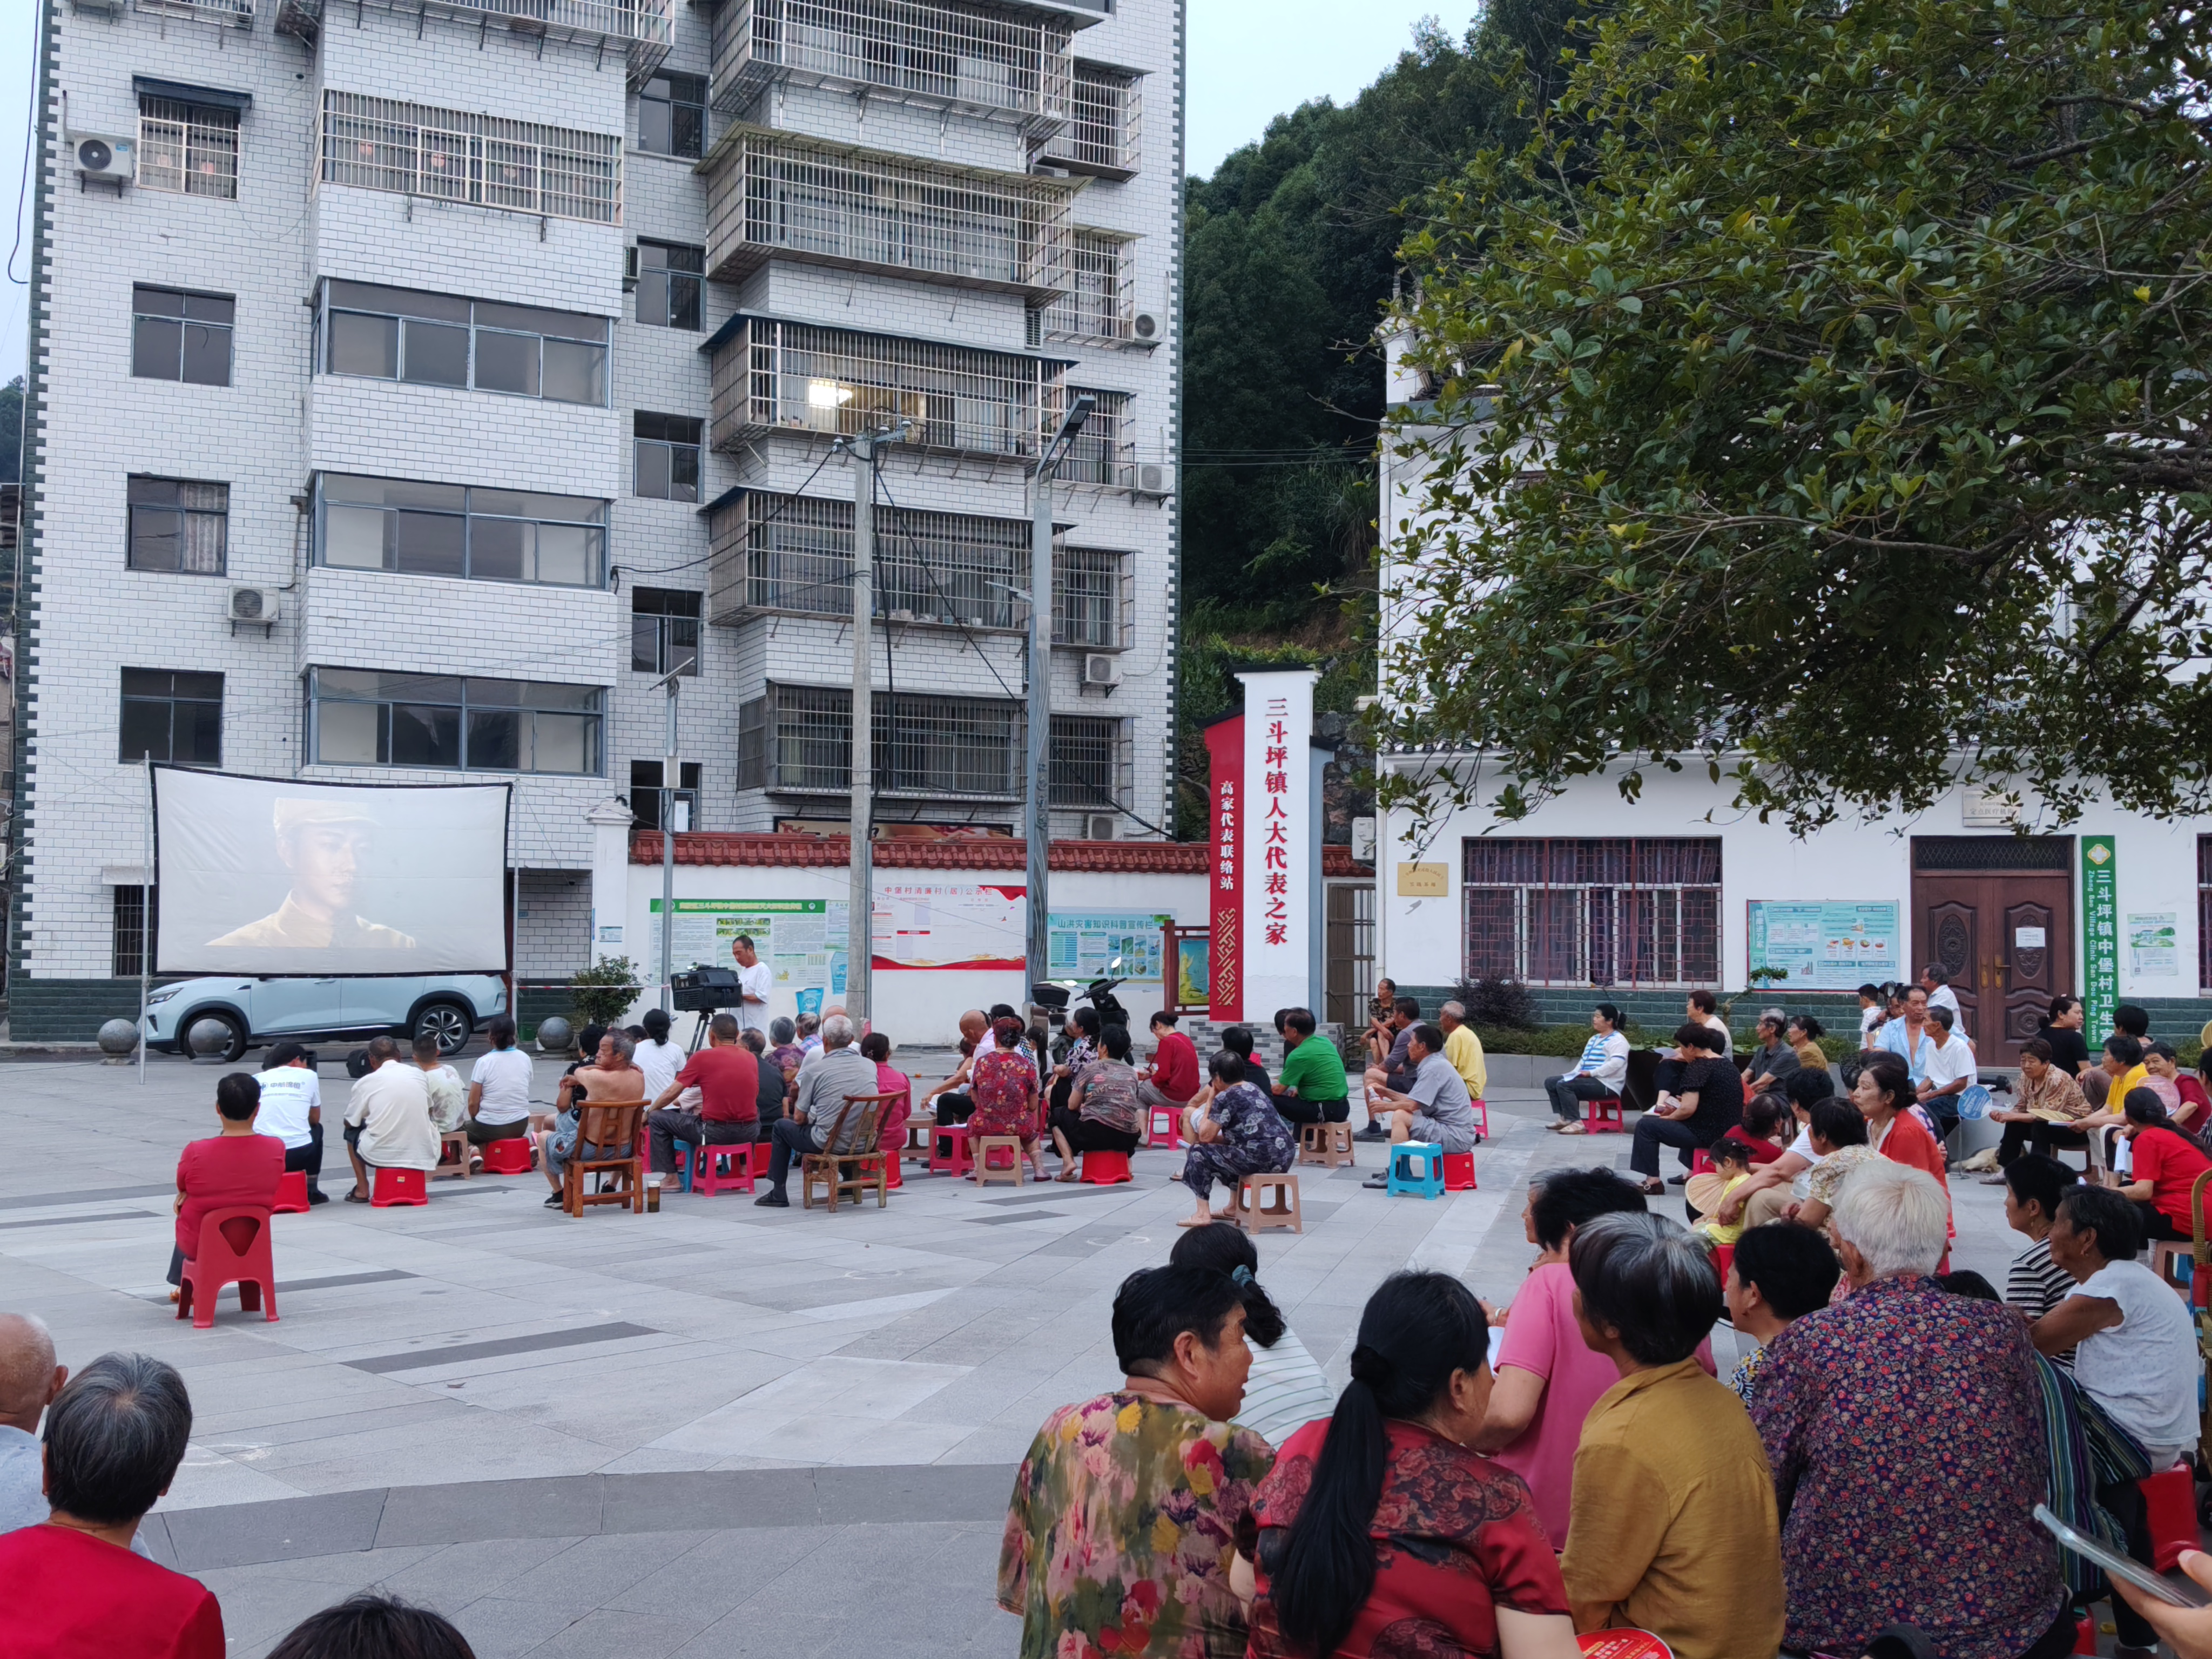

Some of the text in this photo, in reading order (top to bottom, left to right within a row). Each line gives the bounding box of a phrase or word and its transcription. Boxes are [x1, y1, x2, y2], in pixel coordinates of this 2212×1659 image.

[1220, 780, 1234, 890] 高家代表联络站
[1265, 698, 1288, 946] 三斗坪镇人大代表之家
[1058, 919, 1154, 929] 山洪灾害知识科普宣传栏
[2089, 1000, 2098, 1016] Ping
